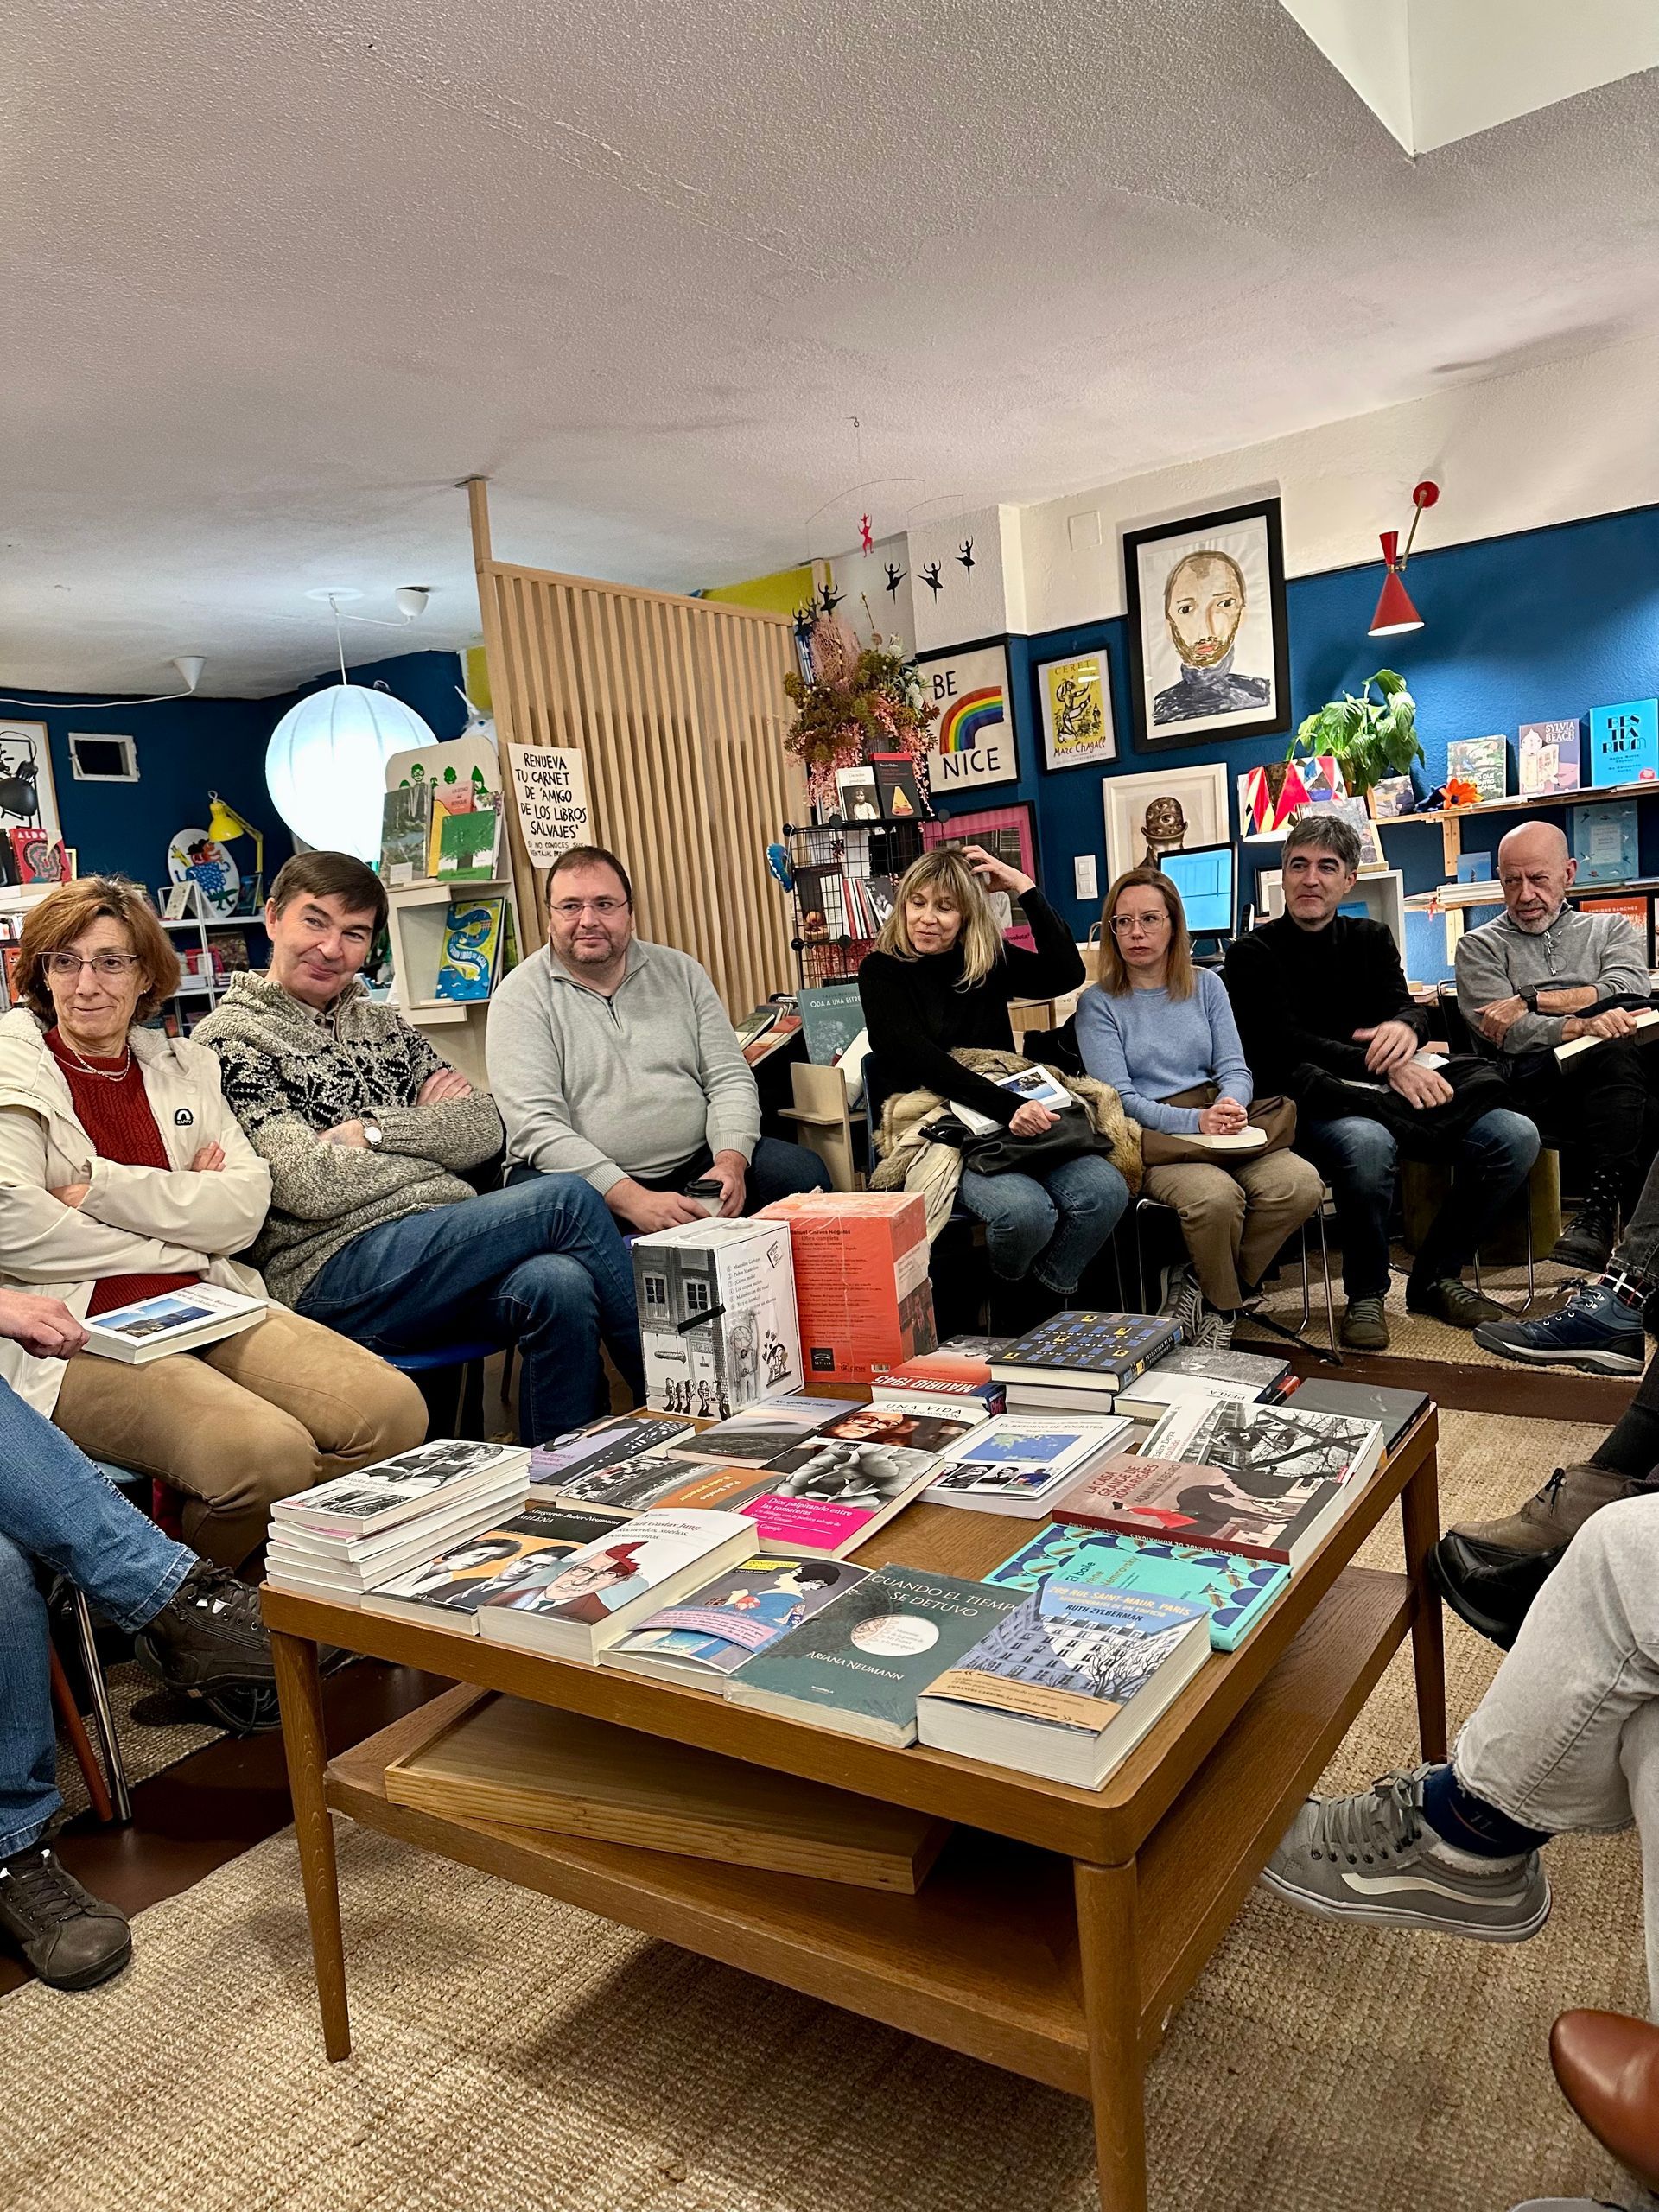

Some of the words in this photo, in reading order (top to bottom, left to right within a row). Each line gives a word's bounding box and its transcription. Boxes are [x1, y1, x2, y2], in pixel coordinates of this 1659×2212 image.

[933, 671, 957, 700] BE
[1545, 721, 1575, 733] SYLVIA
[1545, 731, 1575, 742] BEACH
[524, 753, 567, 770] RENUEVA
[943, 747, 1001, 779] NICE
[515, 769, 528, 783] TU
[531, 771, 569, 787] CARNET
[525, 785, 535, 799] DE
[520, 803, 531, 816] DE
[535, 804, 551, 820] LOS
[554, 806, 587, 823] LIBROS
[810, 1000, 825, 1008] ODA
[872, 1376, 913, 1387] 1945
[910, 1380, 977, 1394] MADRID
[1210, 1389, 1246, 1401] PERLA
[926, 1405, 963, 1414] VIDA
[1084, 1483, 1097, 1494] LA
[1094, 1471, 1117, 1486] CASA
[1097, 1474, 1128, 1497] GRANDE
[1127, 1465, 1141, 1476] DE
[767, 1497, 786, 1506] Dios
[786, 1500, 830, 1512] palpitando
[830, 1508, 853, 1516] entre
[772, 1504, 813, 1516] tomateras
[518, 1514, 554, 1524] MILENA
[677, 1522, 702, 1531] Jung
[1071, 1561, 1096, 1576] baile
[869, 1574, 944, 1596] CUANDO
[946, 1591, 961, 1602] EL
[1070, 1589, 1090, 1598] RUE
[890, 1592, 911, 1605] SE
[909, 1597, 979, 1618] DETUVO
[1065, 1604, 1090, 1613] RUTH
[1090, 1606, 1144, 1622] ZYLBERMAN
[806, 1651, 846, 1666] ARIANA
[846, 1659, 906, 1681] NEUMANN
